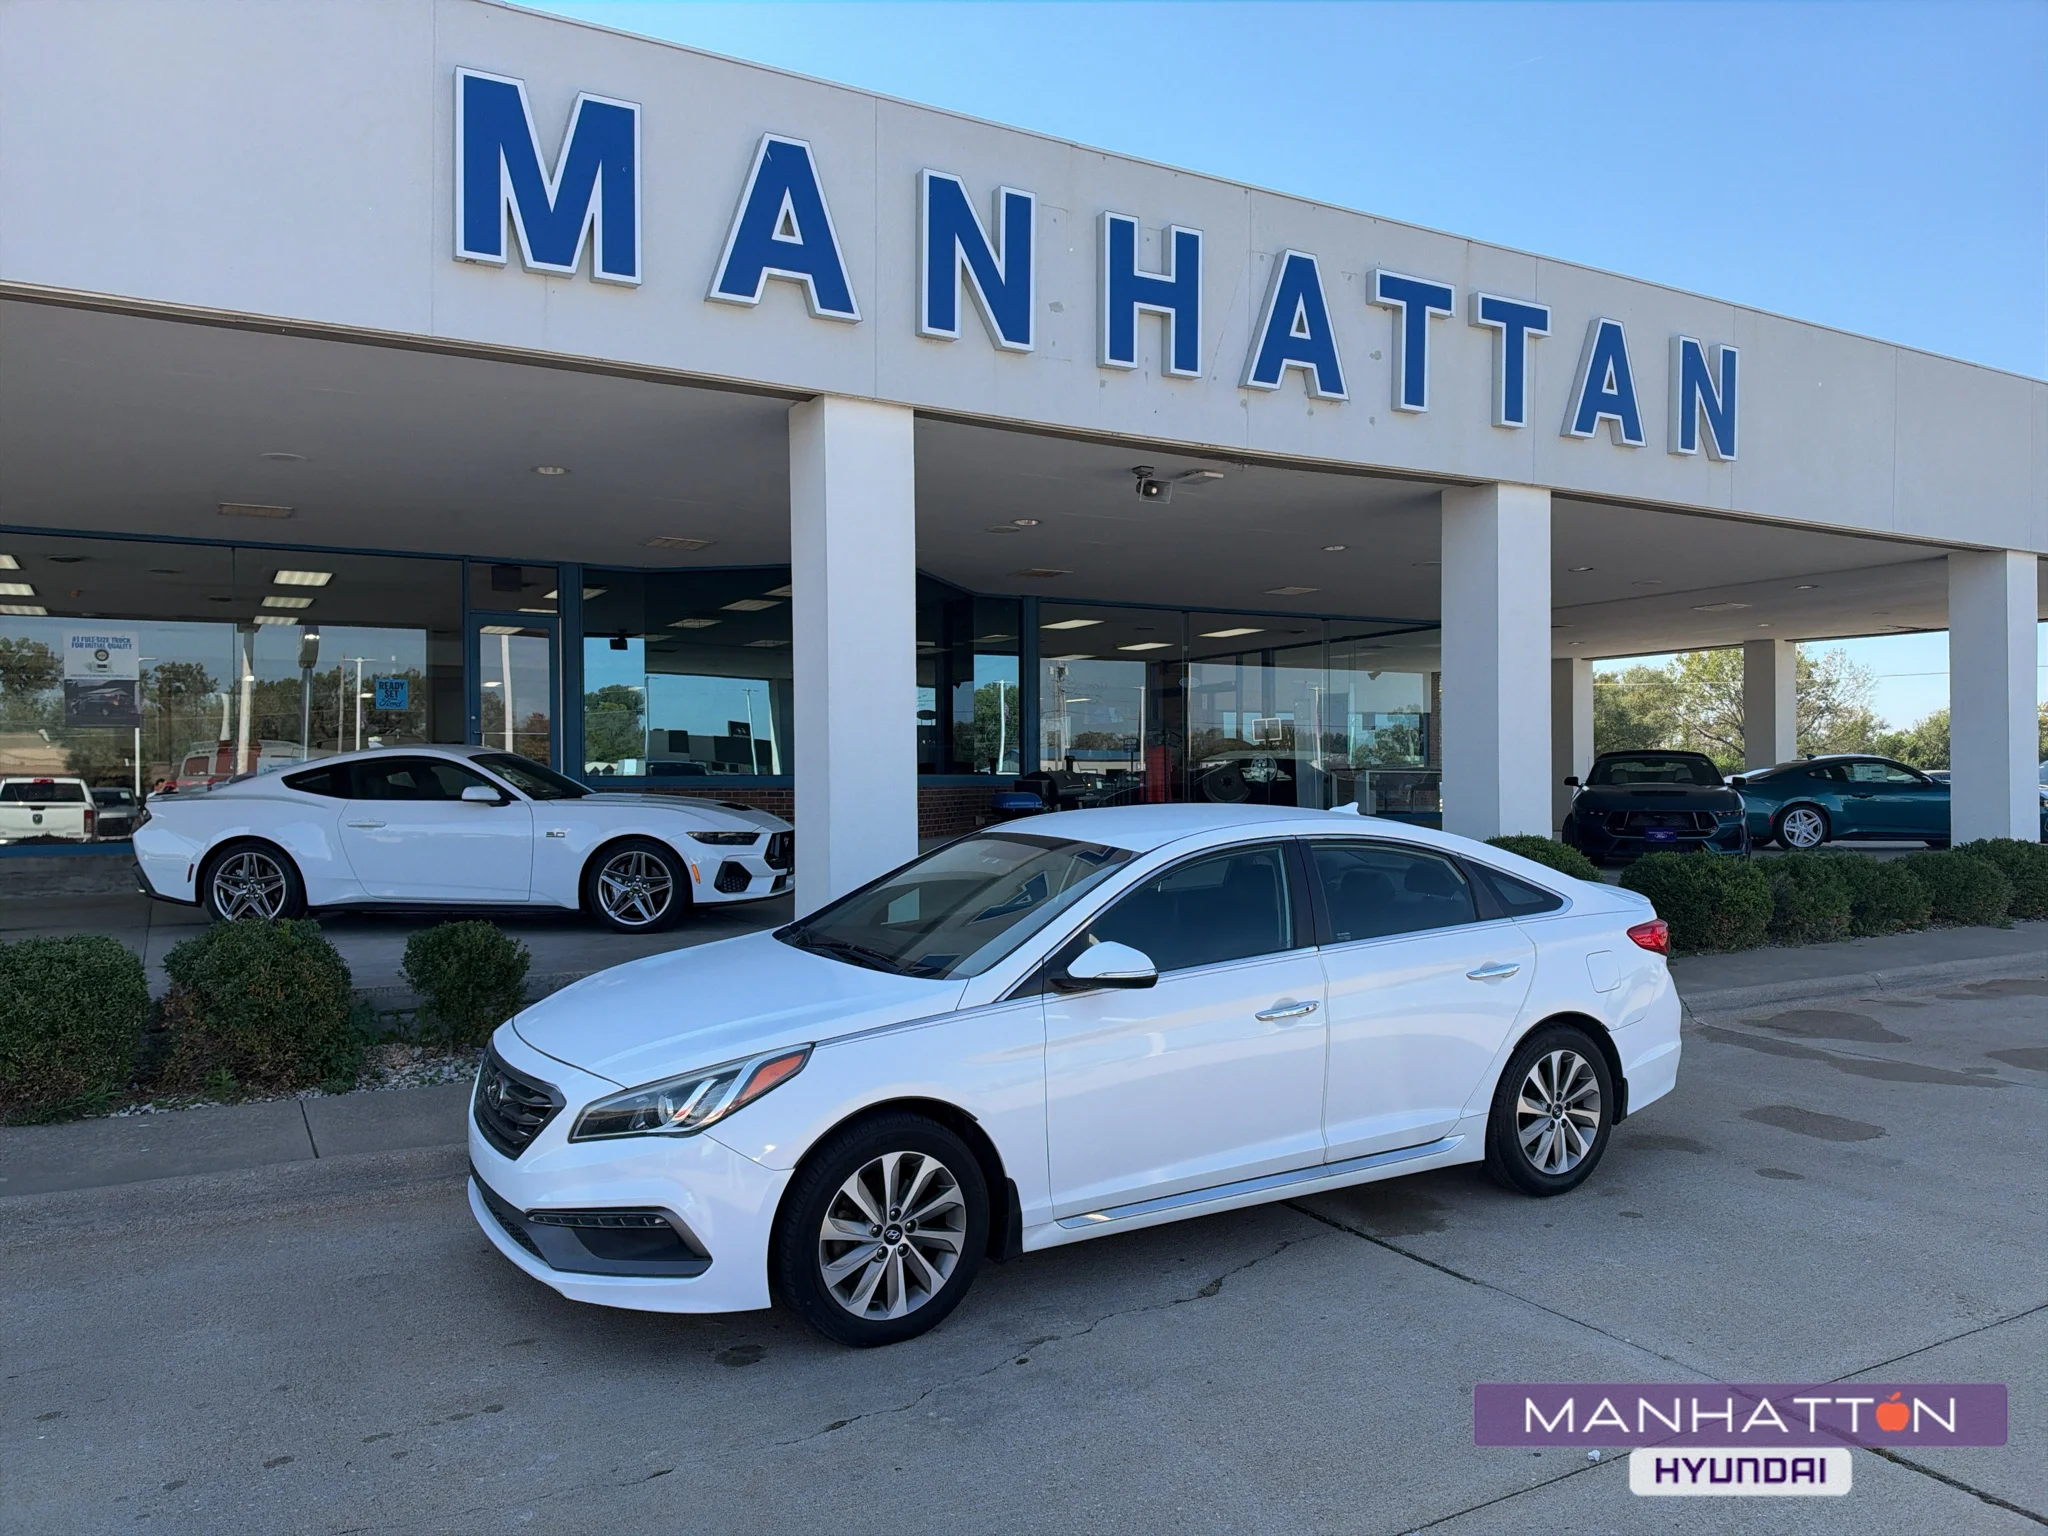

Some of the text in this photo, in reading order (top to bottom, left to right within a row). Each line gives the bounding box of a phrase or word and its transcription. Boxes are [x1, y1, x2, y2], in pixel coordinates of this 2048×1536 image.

[454, 65, 1740, 463] MANHATTAN
[378, 682, 405, 690] READY
[384, 690, 399, 698] SET
[379, 697, 404, 707] Ford
